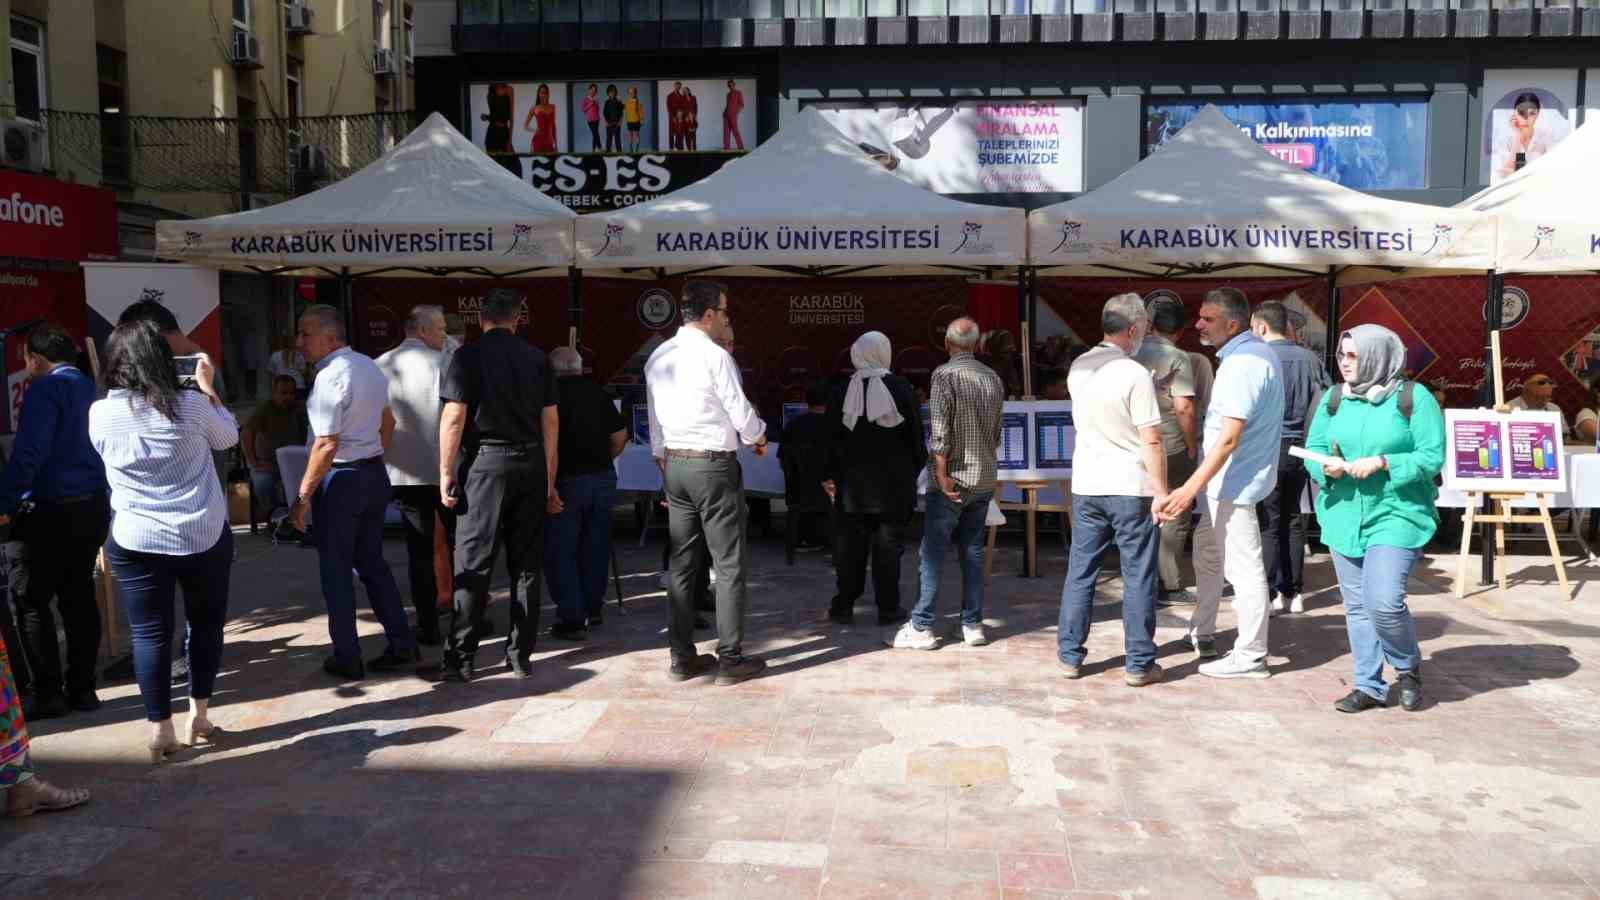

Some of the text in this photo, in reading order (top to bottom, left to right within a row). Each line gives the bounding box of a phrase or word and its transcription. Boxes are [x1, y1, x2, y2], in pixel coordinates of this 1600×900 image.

[1256, 122, 1373, 139] Kalkınmasına
[231, 230, 336, 254] KARABÜK
[342, 227, 493, 253] ÜNİVERSİTESİ
[656, 226, 769, 252] KARABÜK
[776, 225, 940, 250] ÜNİVERSİTESİ
[1120, 224, 1413, 252] KARABÜK ÜNİVERSİTESİ
